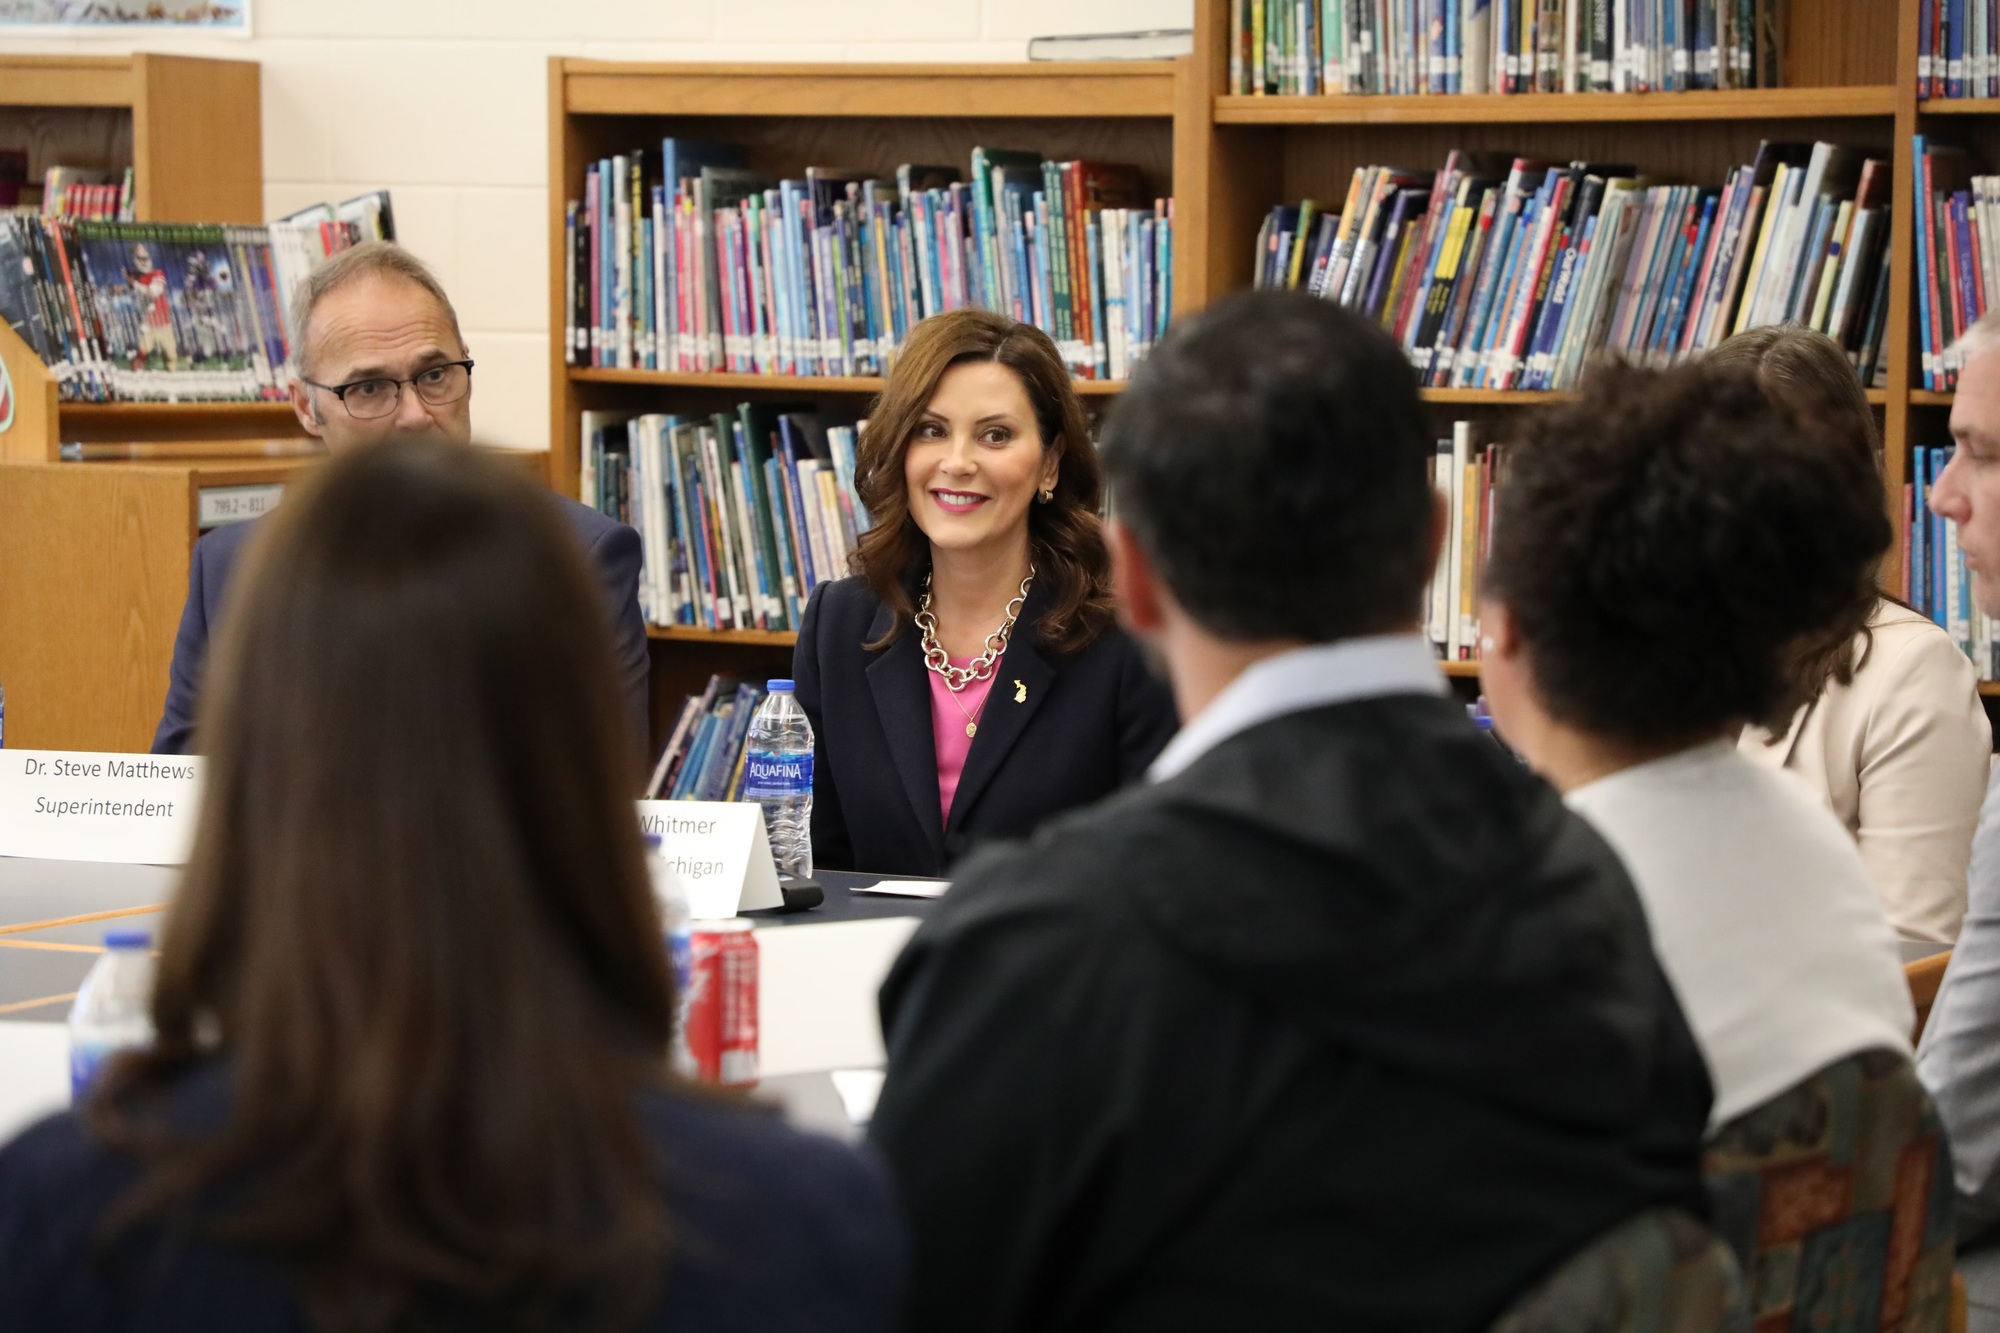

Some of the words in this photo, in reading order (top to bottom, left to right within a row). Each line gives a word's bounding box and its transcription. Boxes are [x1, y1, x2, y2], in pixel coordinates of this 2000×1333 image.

[25, 758, 47, 776] Dr.
[54, 759, 101, 777] Steve
[108, 760, 195, 779] Matthews
[749, 762, 802, 779] AQUAFINA
[35, 796, 174, 818] Superintendent
[639, 814, 717, 834] Whitmer
